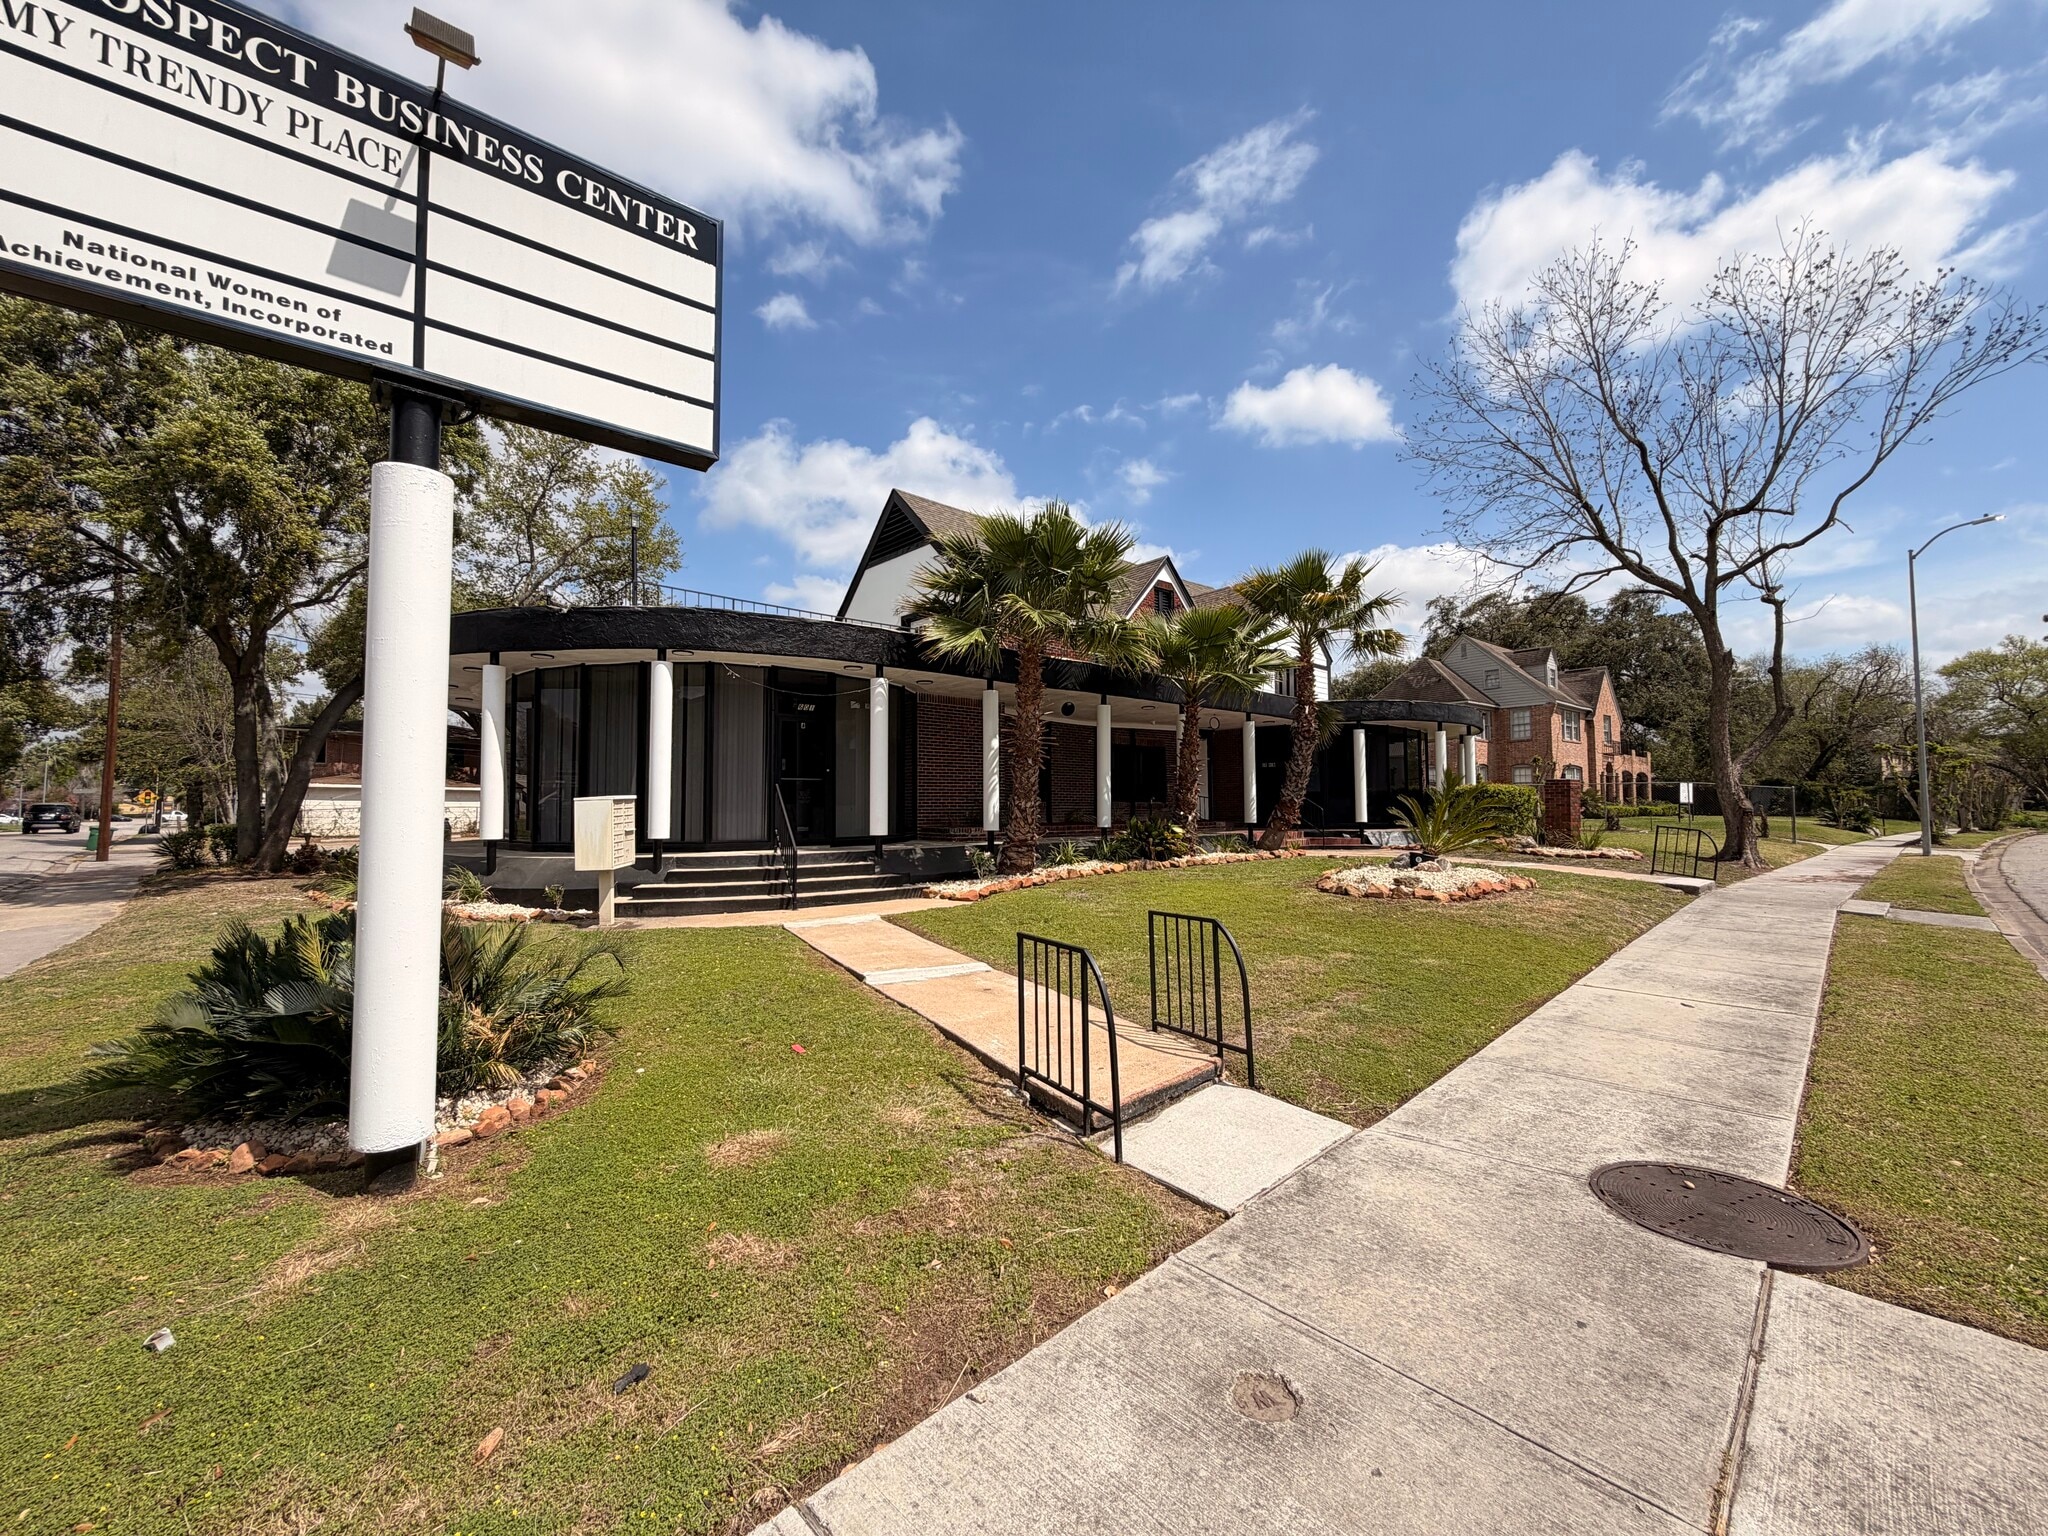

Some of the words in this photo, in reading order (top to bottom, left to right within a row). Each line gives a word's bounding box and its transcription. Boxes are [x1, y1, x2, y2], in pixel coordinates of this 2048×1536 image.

[0, 0, 75, 49] MY
[90, 27, 274, 127] TRENDY
[286, 105, 402, 178] PLACE
[333, 69, 544, 184] BUSINESS
[556, 168, 698, 251] CENTER
[62, 229, 197, 282] National
[207, 271, 308, 314] Women
[316, 306, 342, 323] of
[222, 296, 393, 356] Incorporated
